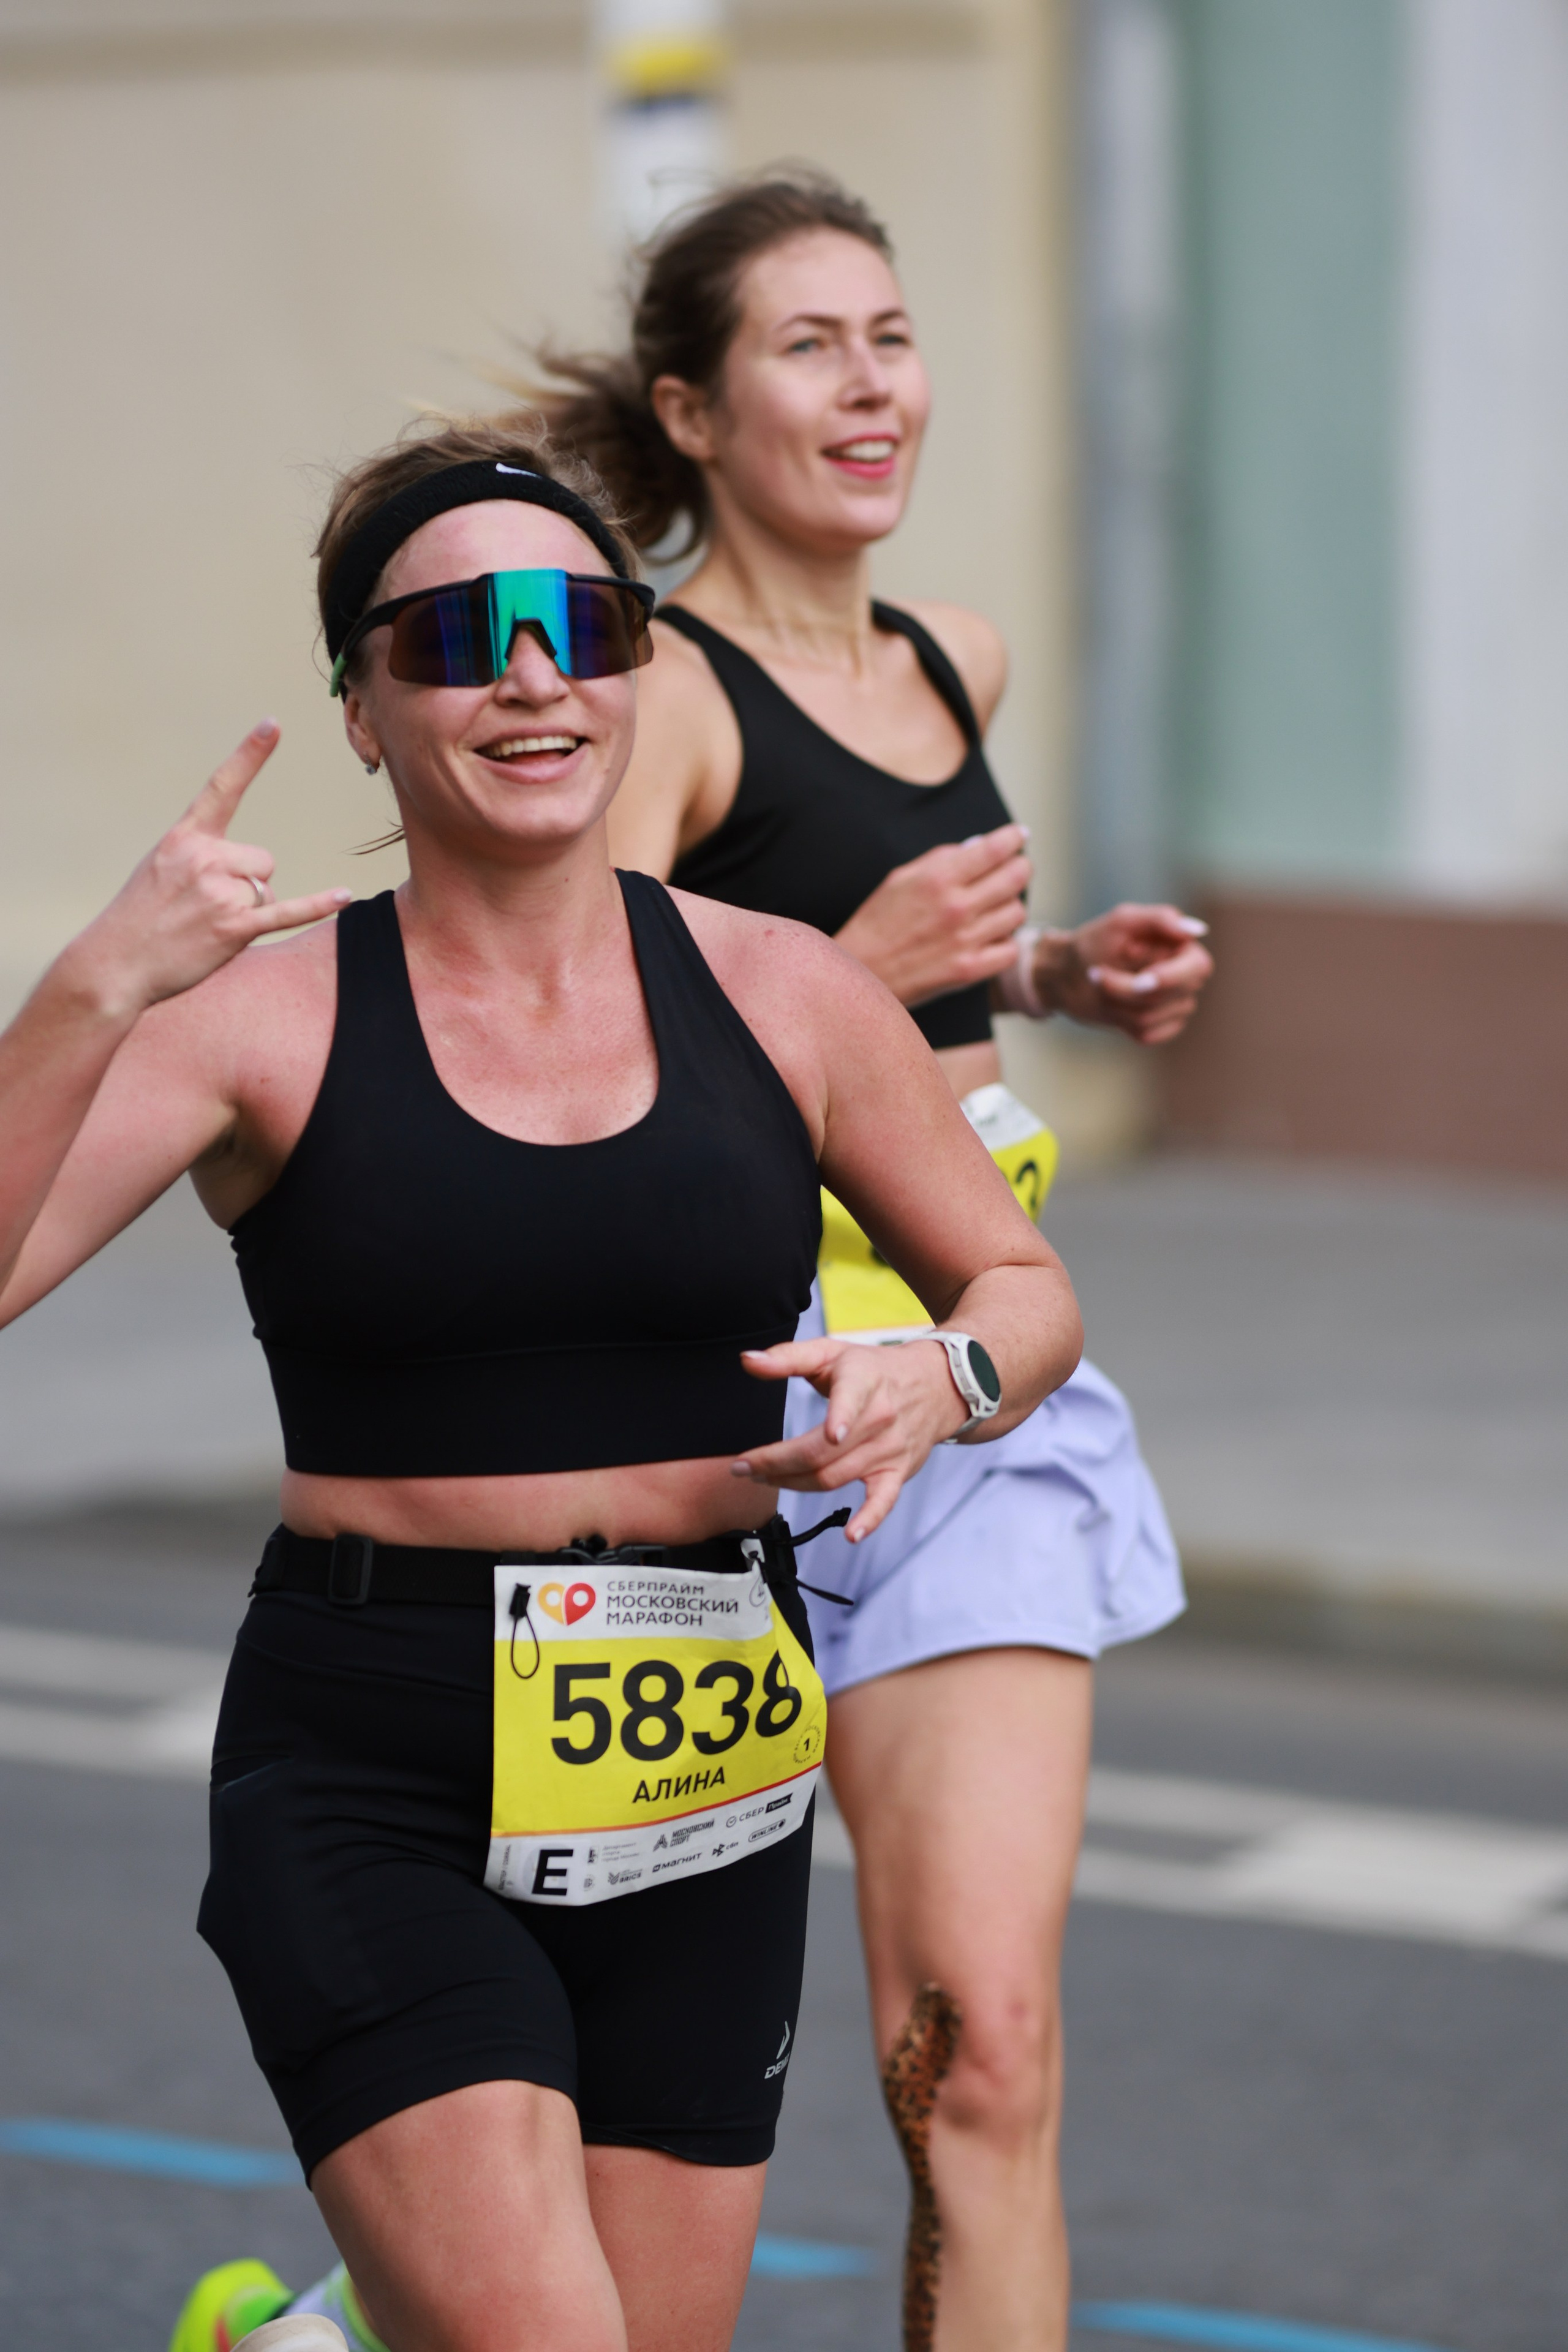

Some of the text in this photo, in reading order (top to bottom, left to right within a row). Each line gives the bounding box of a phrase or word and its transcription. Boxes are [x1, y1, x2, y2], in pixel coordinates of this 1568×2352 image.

[606, 1580, 704, 1596] СБЕРПРАЙМ
[606, 1594, 739, 1613] МОСКОВСКИЙ
[606, 1611, 703, 1627] МАРАФОН
[551, 1649, 802, 1765] 5838
[804, 1738, 810, 1752] 1
[632, 1766, 726, 1804] АЛИНА
[739, 1806, 764, 1823] СБЕР
[671, 1819, 715, 1838] МОСКОВСКИЙ
[751, 1823, 778, 1839] WINLINE
[669, 1834, 691, 1847] СПОРТ
[532, 1849, 574, 1896] E
[619, 1872, 642, 1883] BRICS
